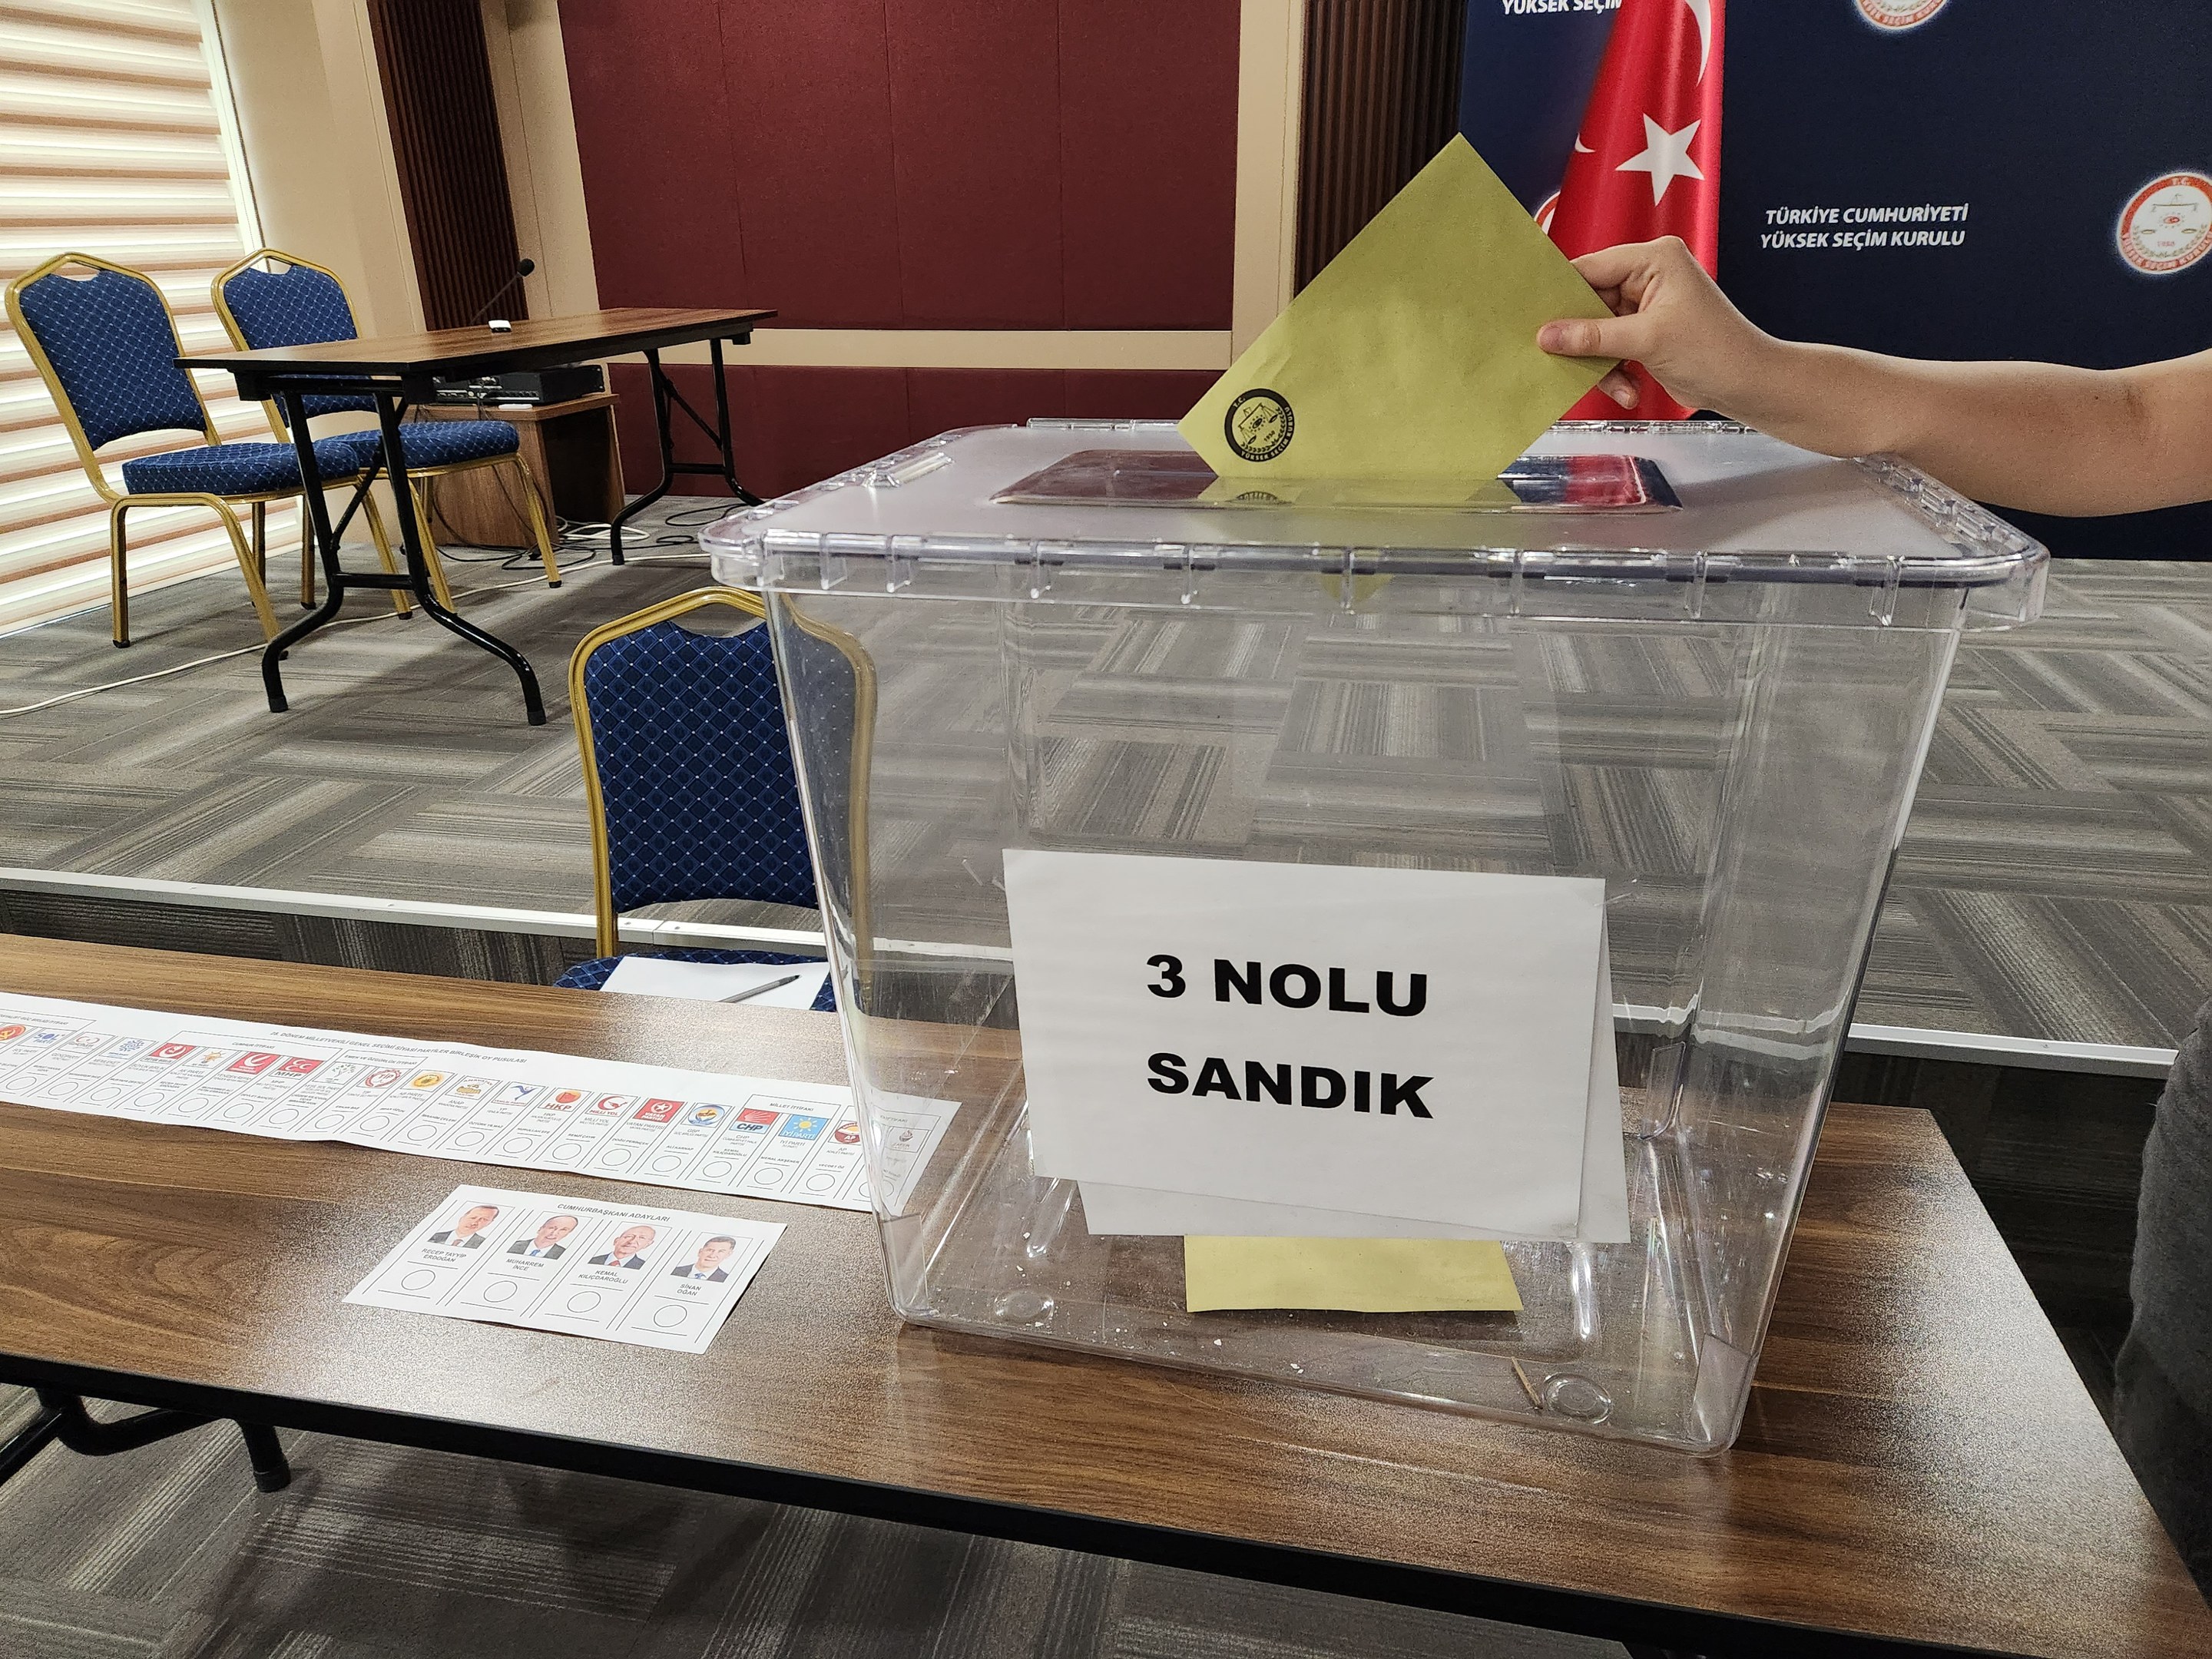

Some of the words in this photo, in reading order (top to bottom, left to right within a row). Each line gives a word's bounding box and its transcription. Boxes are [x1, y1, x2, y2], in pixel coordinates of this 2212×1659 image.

[1766, 206, 1839, 224] TÜRKİYE
[1843, 203, 1969, 224] CUMHURİYETİ
[1760, 230, 1830, 248] YÜKSEK
[1833, 229, 1887, 250] SEÇİM
[1891, 230, 1965, 247] KURULU
[1147, 954, 1186, 998] 3
[1214, 959, 1427, 1017] NOLU
[306, 1035, 349, 1045] MİLLETVEKİLİ
[449, 1049, 480, 1059] BİRLEŞİK
[1147, 1052, 1434, 1119] SANDIK
[737, 1123, 763, 1131] CHP
[558, 1204, 628, 1217] CUMHURBAŞKANI
[628, 1213, 671, 1222] ADAYLARI
[423, 1254, 456, 1263] ERDOĞAN
[505, 1259, 545, 1268] MUHARREM
[578, 1274, 628, 1284] KILIÇDAROĞLU
